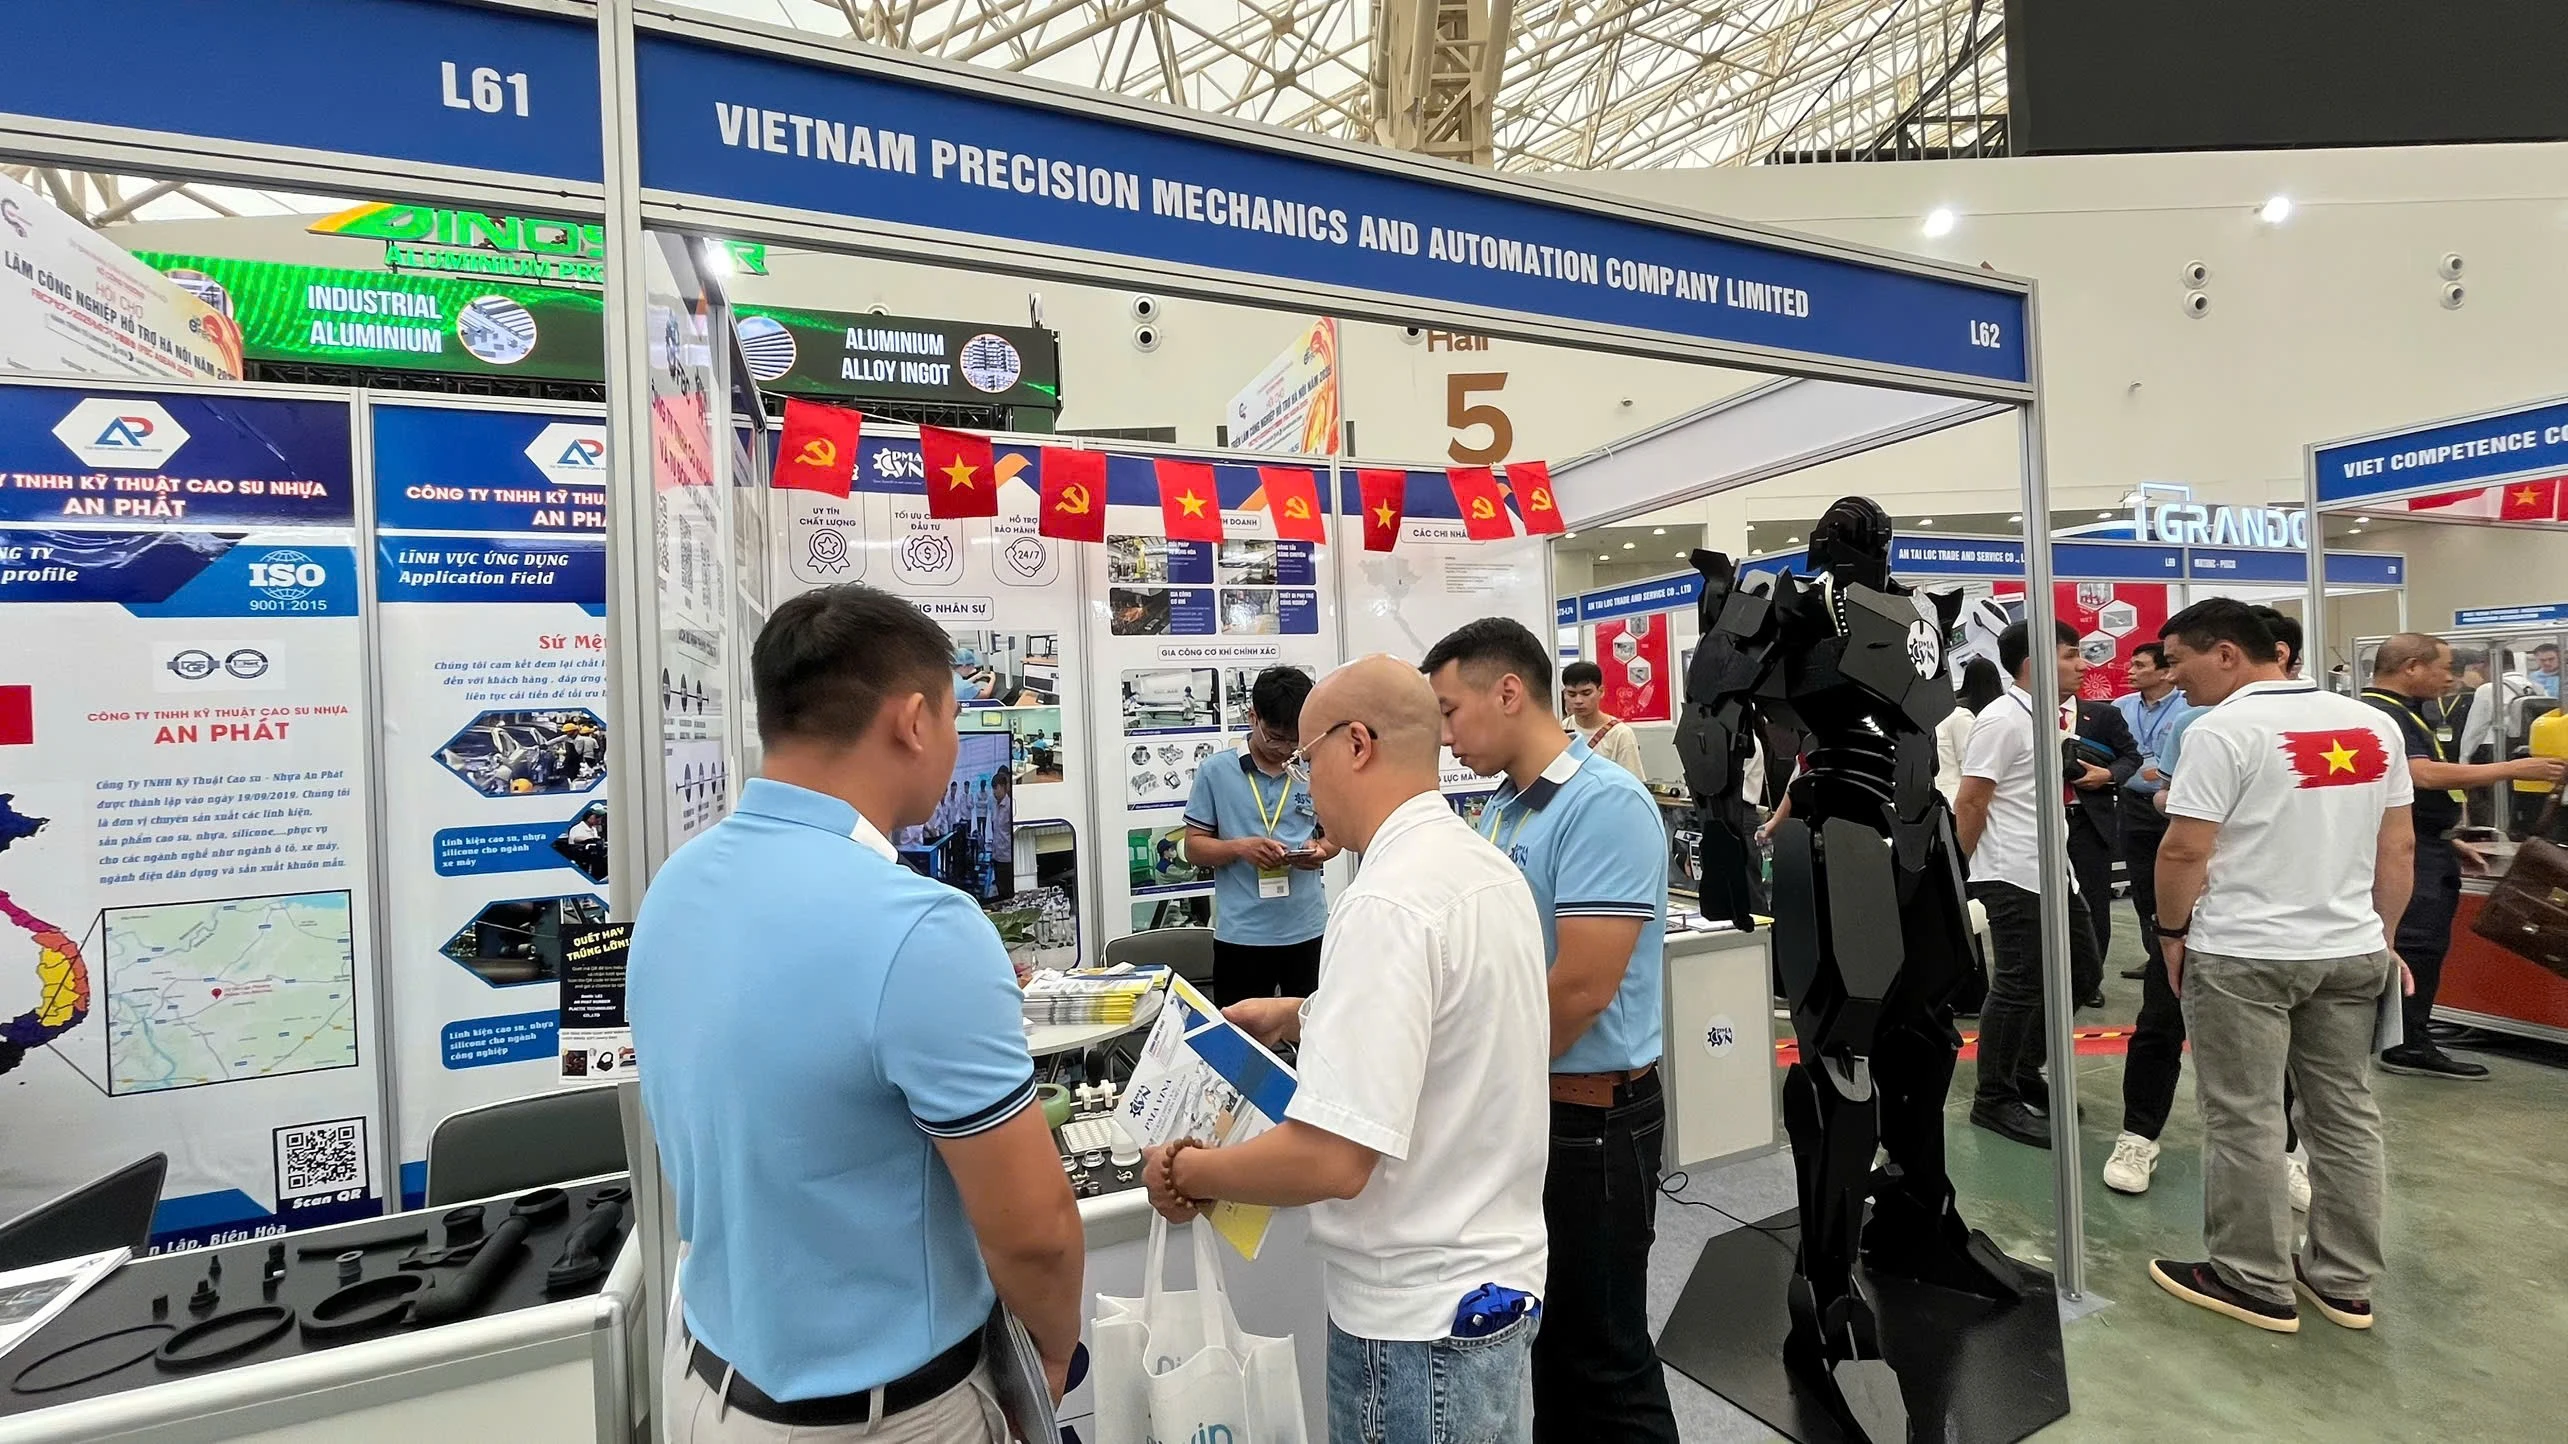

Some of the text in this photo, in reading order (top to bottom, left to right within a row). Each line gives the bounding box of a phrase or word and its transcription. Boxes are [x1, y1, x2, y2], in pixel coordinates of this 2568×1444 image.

[441, 61, 529, 117] L61
[715, 102, 1810, 319] VIETNAM PRECISION MECHANICS AND AUTOMATION COMPANY LIMITED
[385, 245, 550, 280] ALUMINIUM
[38, 266, 72, 300] CÔNG
[75, 288, 117, 325] NGHIỆP
[138, 324, 157, 347] TRỢ
[307, 284, 443, 321] INDUSTRIAL
[310, 319, 443, 354] ALUMINIUM
[845, 326, 945, 357] ALUMINIUM
[1969, 319, 2001, 349] L62
[841, 356, 951, 387] ALLOY INGOT
[1447, 372, 1513, 465] 5
[2344, 457, 2385, 479] VIET
[2391, 431, 2537, 471] COMPETENCE
[13, 473, 328, 498] TNHH KỸ THUẬT CAO SU NHỰA
[406, 484, 464, 501] CÔNG
[467, 488, 488, 501] TY
[493, 489, 541, 503] TNHH
[545, 487, 568, 505] KỸ
[63, 496, 186, 517] AN PHÁT
[812, 507, 840, 515] UY TÍN
[532, 510, 565, 527] AN
[800, 516, 823, 526] CHẤT
[1230, 517, 1258, 526] DOANH
[1413, 528, 1432, 538] CÁC
[1433, 530, 1449, 538] CHI
[30, 547, 54, 559] TY
[398, 549, 569, 570] LĨNH VỰC ỨNG DỤNG
[1018, 550, 1040, 560] 24/7
[1911, 549, 1922, 560] TAI
[1923, 549, 1937, 560] LOC
[1938, 550, 1960, 561] TRADE
[1961, 551, 1975, 562] AND
[1976, 551, 2004, 562] SERVICE
[1, 566, 78, 585] profile
[249, 563, 326, 587] ISO
[398, 570, 554, 588] Application Field
[1604, 599, 1613, 608] LOC
[1614, 597, 1630, 606] TRADE
[1631, 593, 1643, 603] AND
[1643, 588, 1665, 601] SERVICE
[1680, 584, 1692, 595] LTD
[250, 599, 328, 612] 9001:2015
[935, 602, 969, 614] NHÂN
[972, 604, 986, 616] SỰ
[539, 633, 567, 650] Sứ
[1161, 646, 1277, 657] GIA CÔNG CƠ KHÍ CHÍNH XÁC
[490, 660, 512, 669] cam
[87, 704, 348, 722] CÔNG TY TNHH KỸ THUẬT CAO SU NHỰA
[154, 718, 289, 744] AN PHÁT
[1443, 774, 1459, 784] LỰC
[488, 836, 505, 844] cao
[442, 848, 479, 857] silicone
[481, 846, 498, 854] cho
[442, 860, 454, 868] xe
[292, 1188, 362, 1209] Scan QR
[254, 1223, 287, 1239] Hòa
